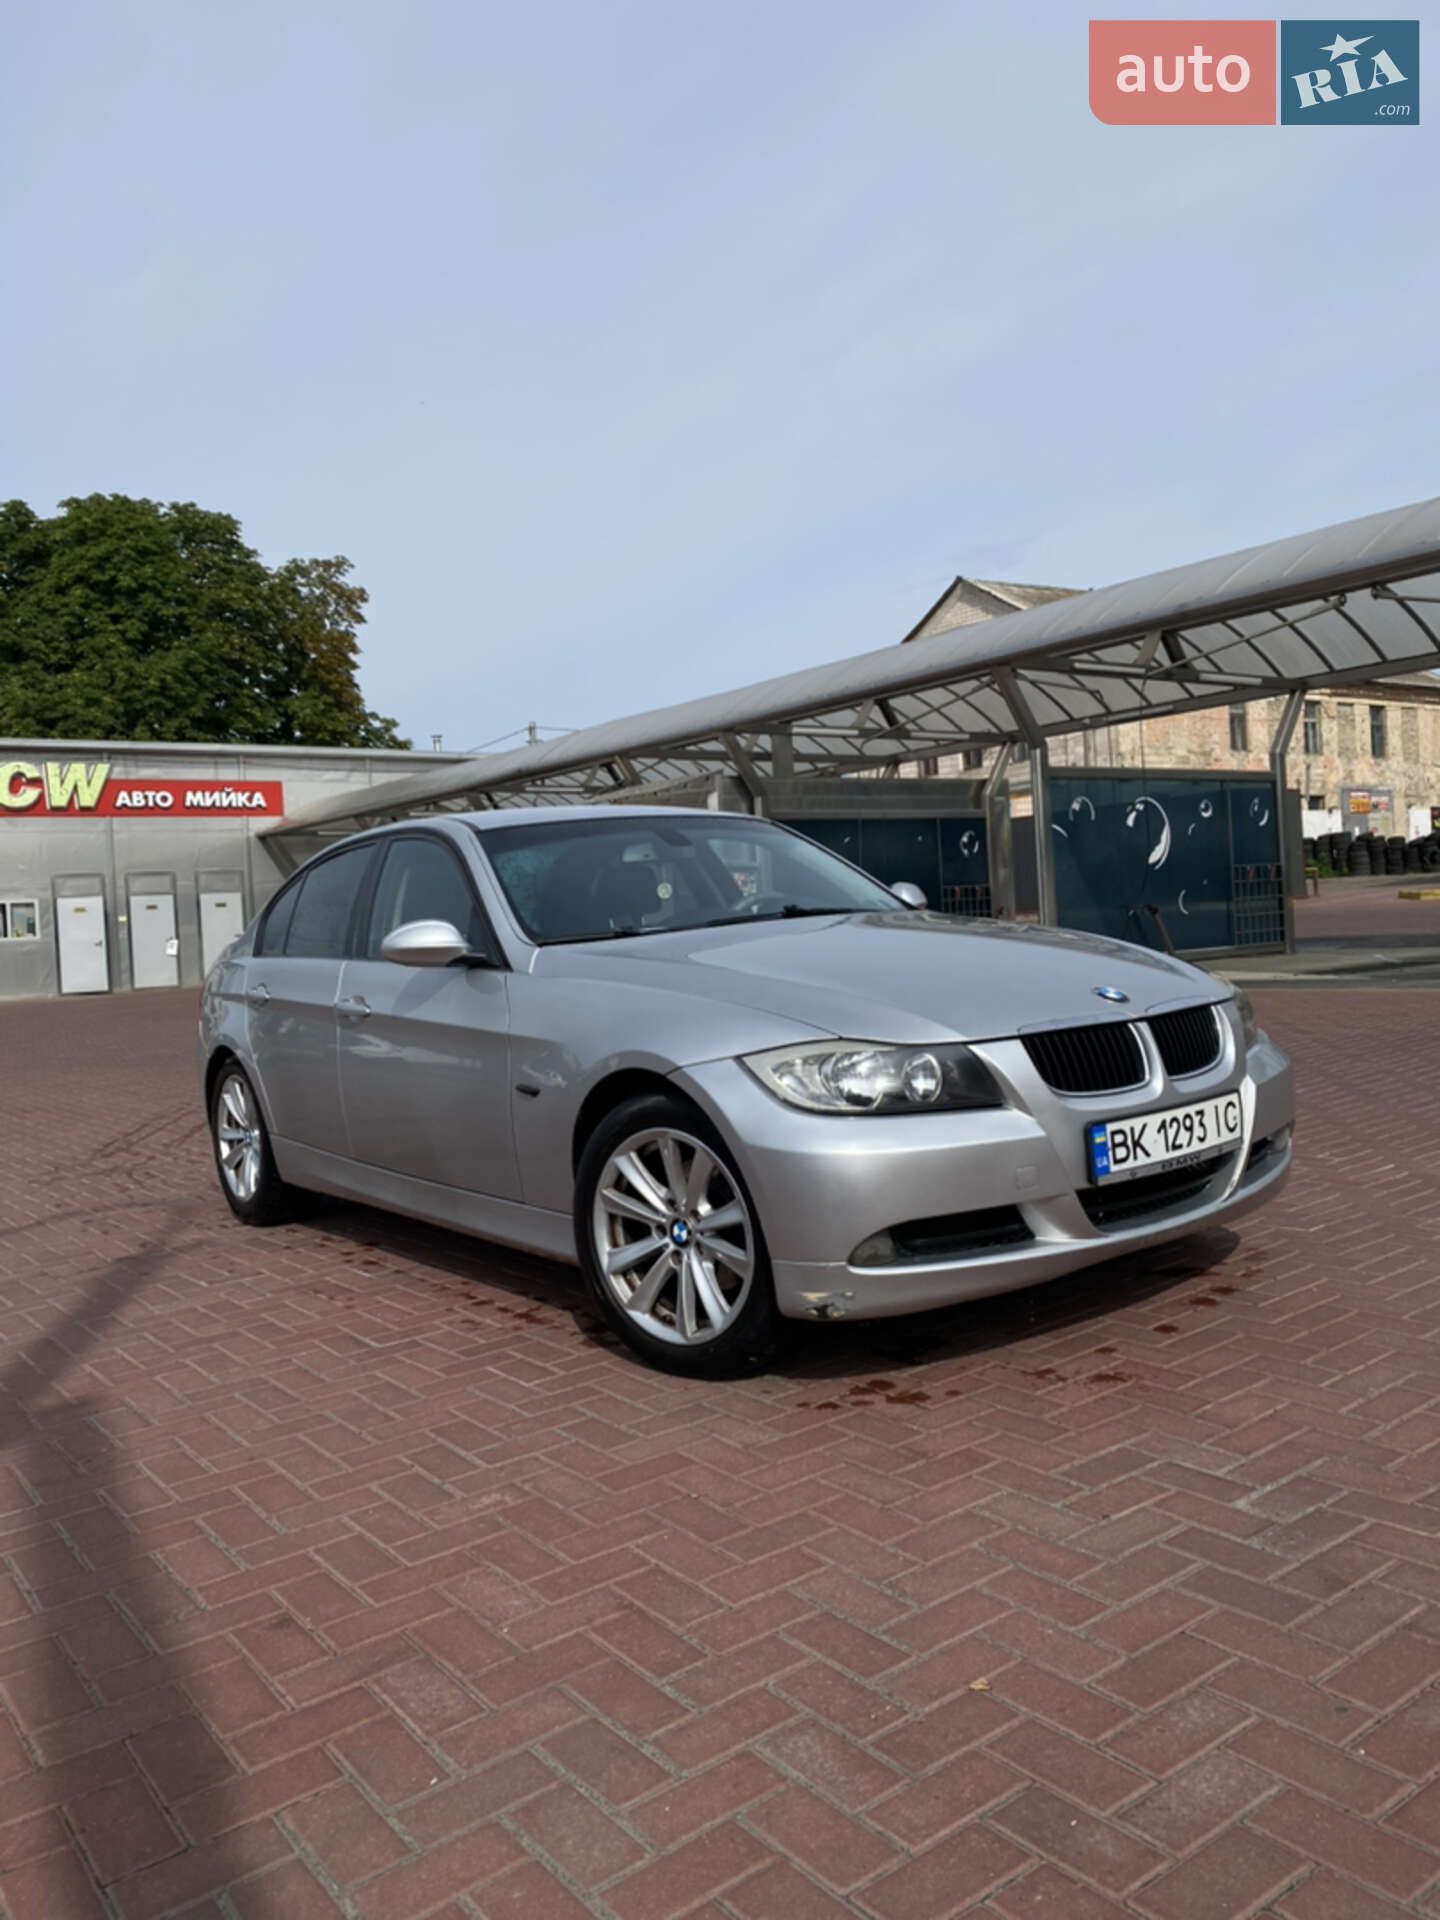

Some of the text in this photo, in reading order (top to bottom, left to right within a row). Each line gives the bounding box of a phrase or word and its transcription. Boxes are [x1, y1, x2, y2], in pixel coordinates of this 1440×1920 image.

[115, 787, 268, 808] АВТО МИЙКА
[1110, 1100, 1239, 1166] BK 1293 IC
